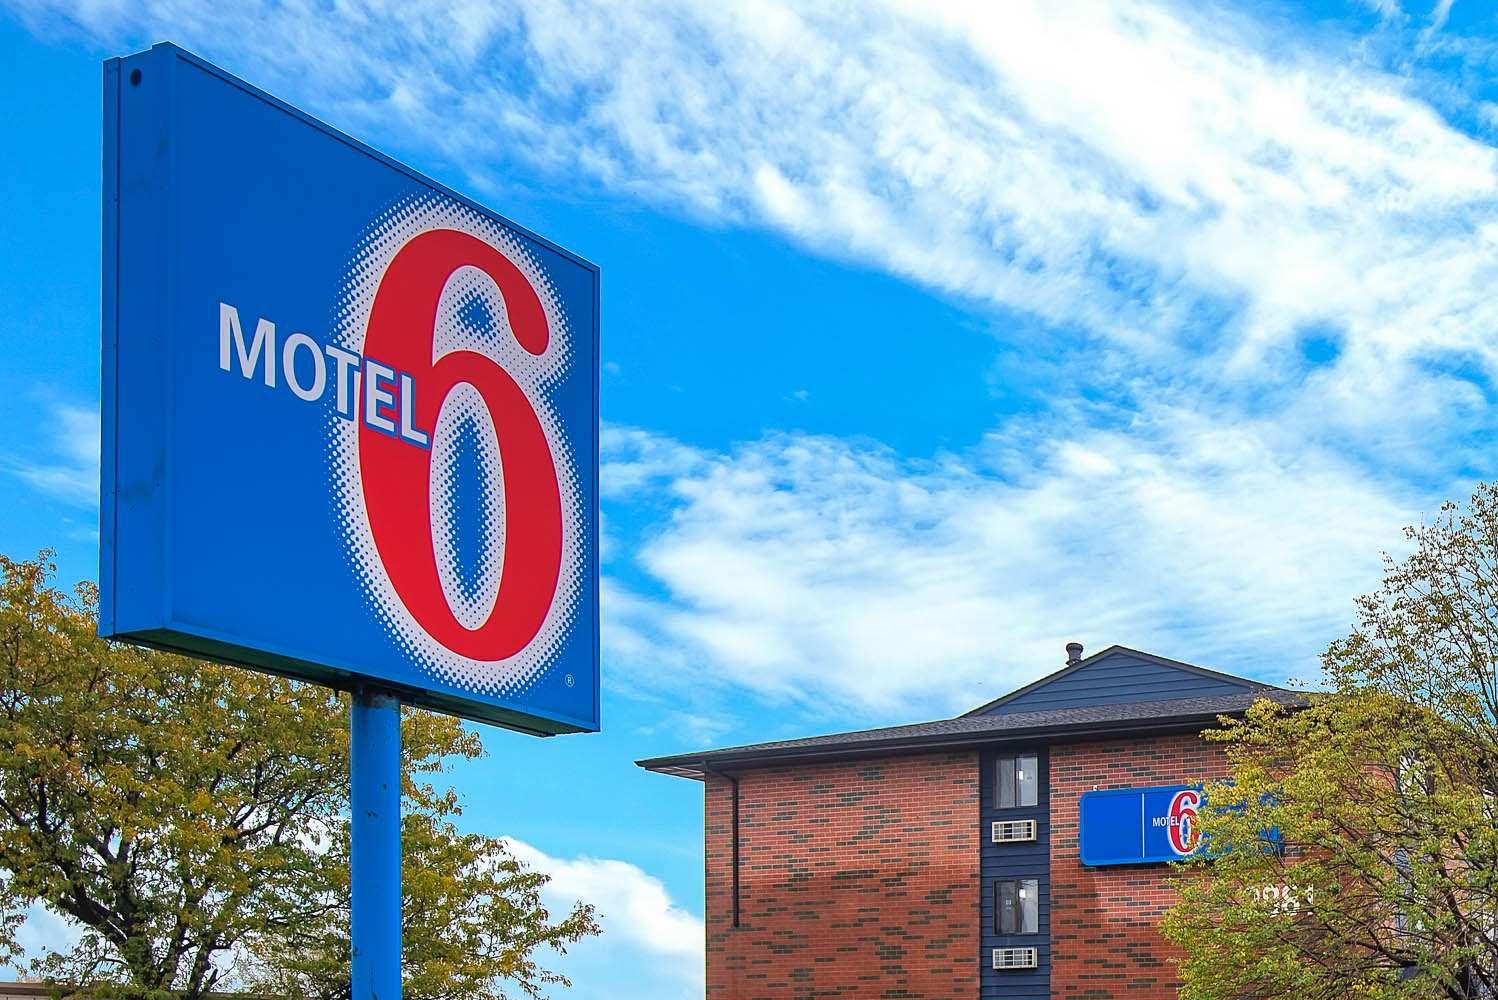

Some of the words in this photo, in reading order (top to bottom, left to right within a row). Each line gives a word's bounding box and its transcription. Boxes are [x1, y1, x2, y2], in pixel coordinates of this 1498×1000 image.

[219, 301, 429, 446] MOTEL
[358, 228, 564, 662] 6
[1152, 815, 1180, 827] MOTEL
[1169, 791, 1200, 853] 6
